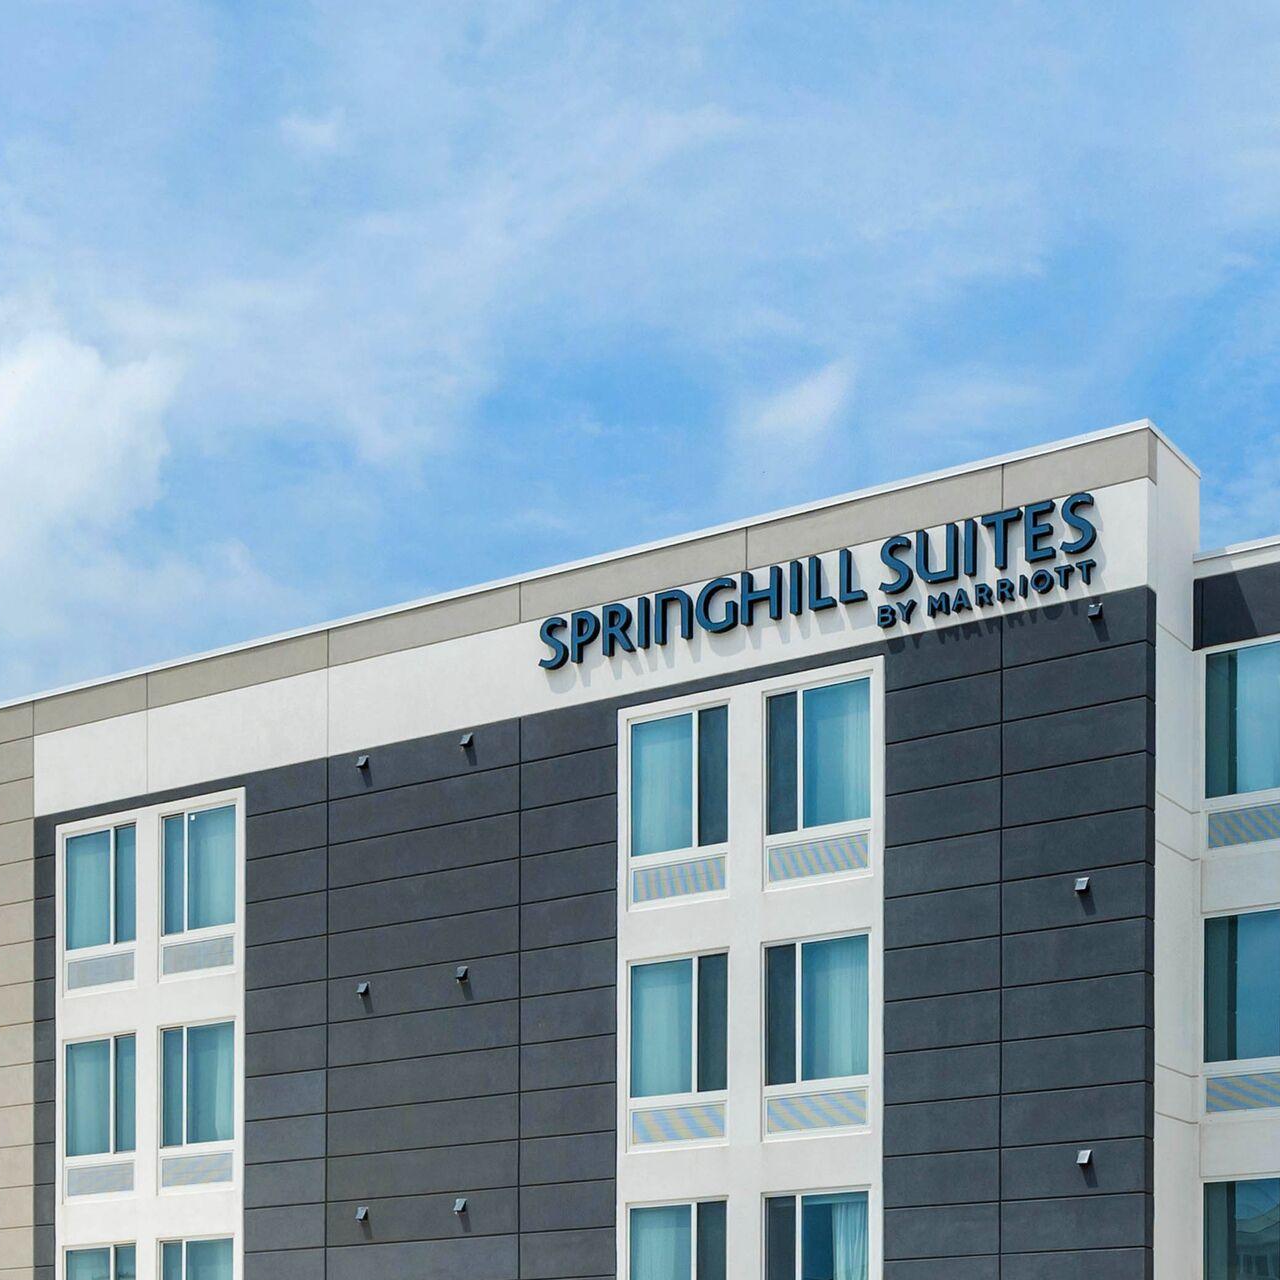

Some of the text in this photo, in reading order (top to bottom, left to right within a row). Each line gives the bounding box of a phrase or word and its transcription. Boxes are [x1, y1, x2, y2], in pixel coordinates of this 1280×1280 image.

[538, 491, 1098, 671] SPRINGHILL SUITES
[877, 559, 1097, 630] BY MARRIOTT
